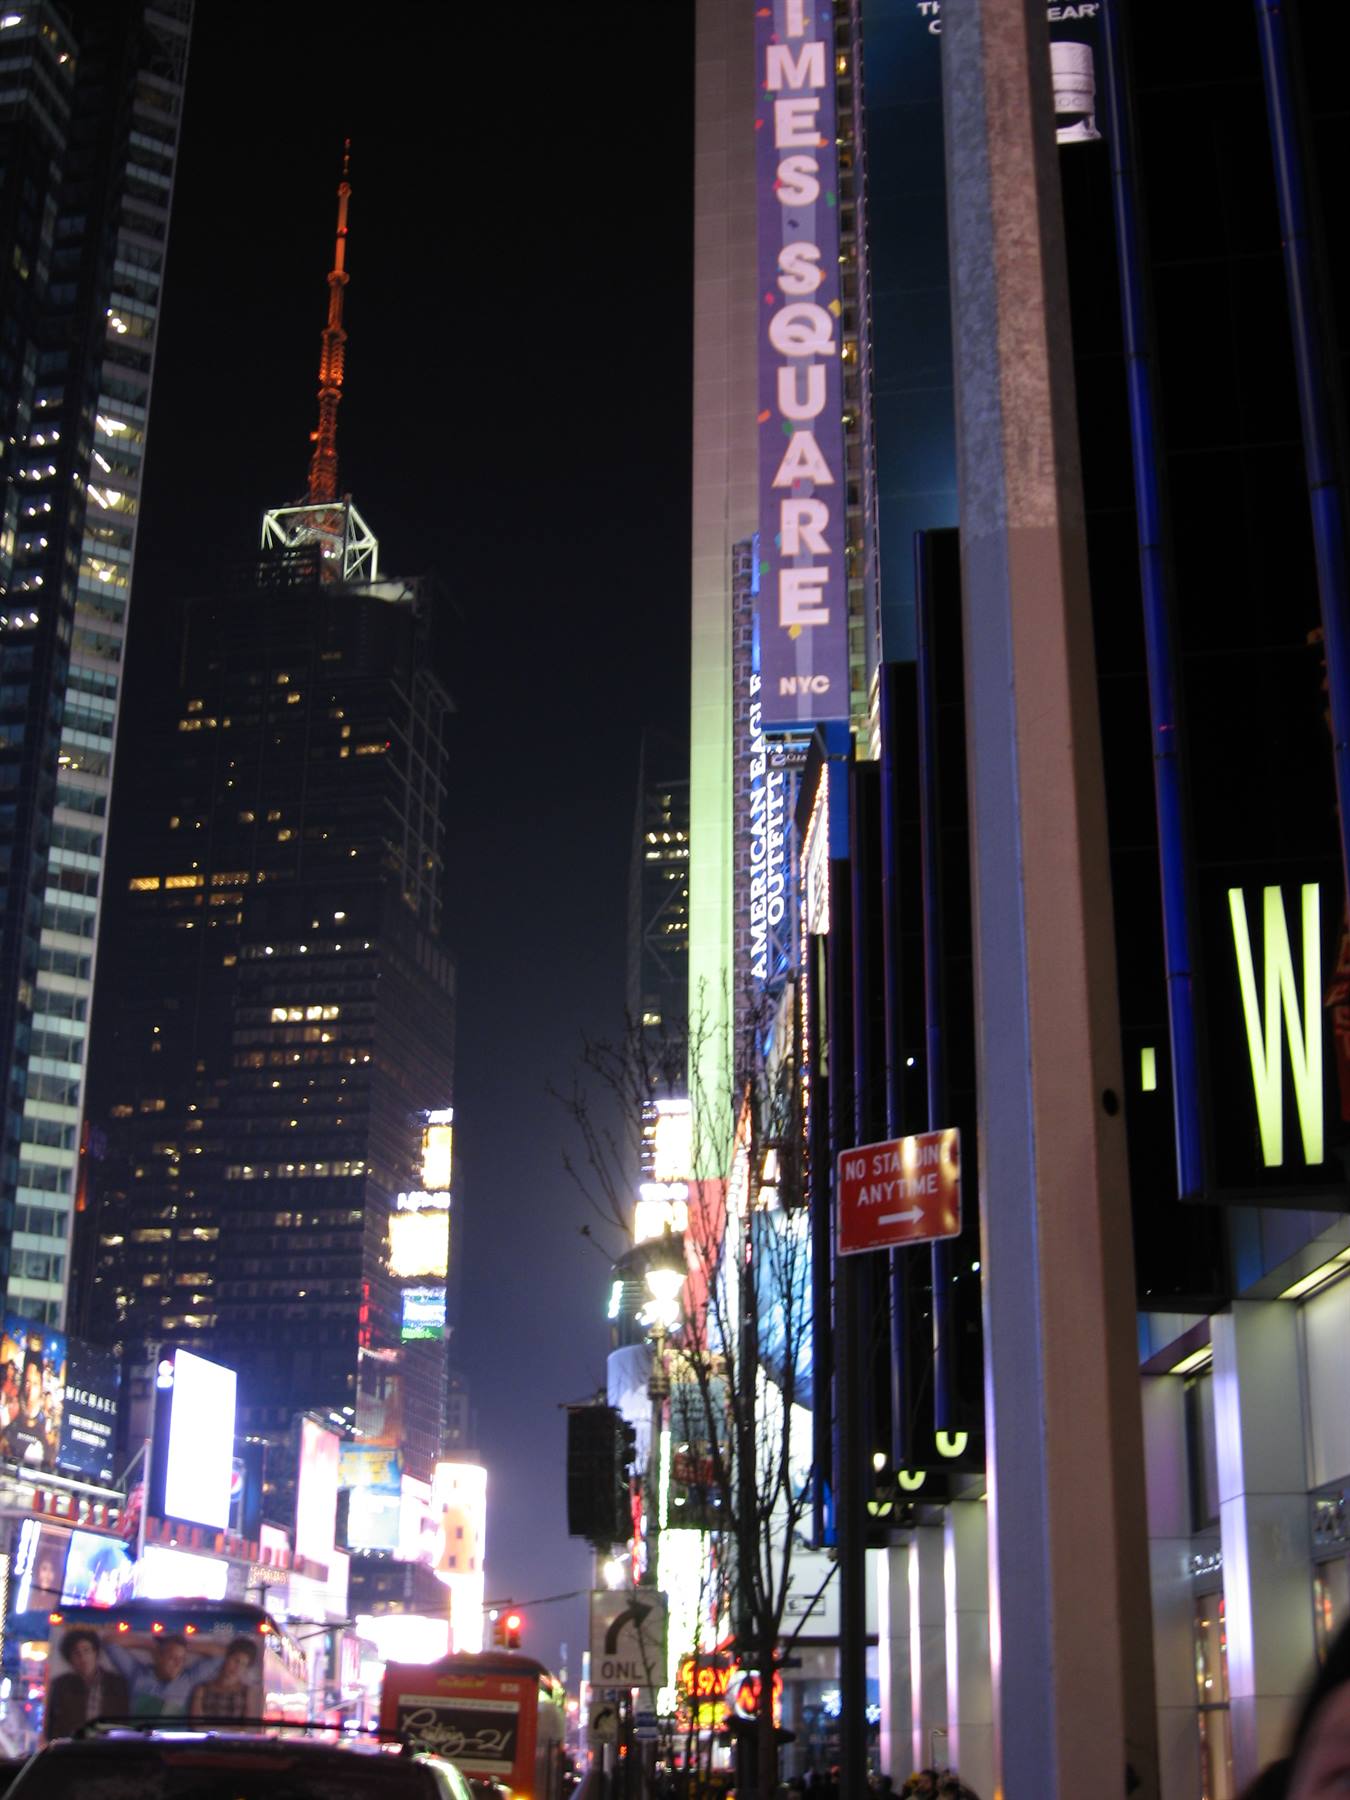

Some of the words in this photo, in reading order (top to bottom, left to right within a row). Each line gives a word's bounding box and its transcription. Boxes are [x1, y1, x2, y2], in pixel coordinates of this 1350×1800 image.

[768, 243, 836, 627] SQUARE
[779, 675, 830, 696] NYC
[750, 786, 767, 980] AMERICAN
[1228, 883, 1324, 1168] W
[845, 1158, 866, 1181] NO
[872, 1143, 951, 1176] STADIN
[857, 1172, 939, 1208] ANYTIME
[65, 1385, 118, 1415] MICHAEL
[601, 1660, 657, 1682] ONLY
